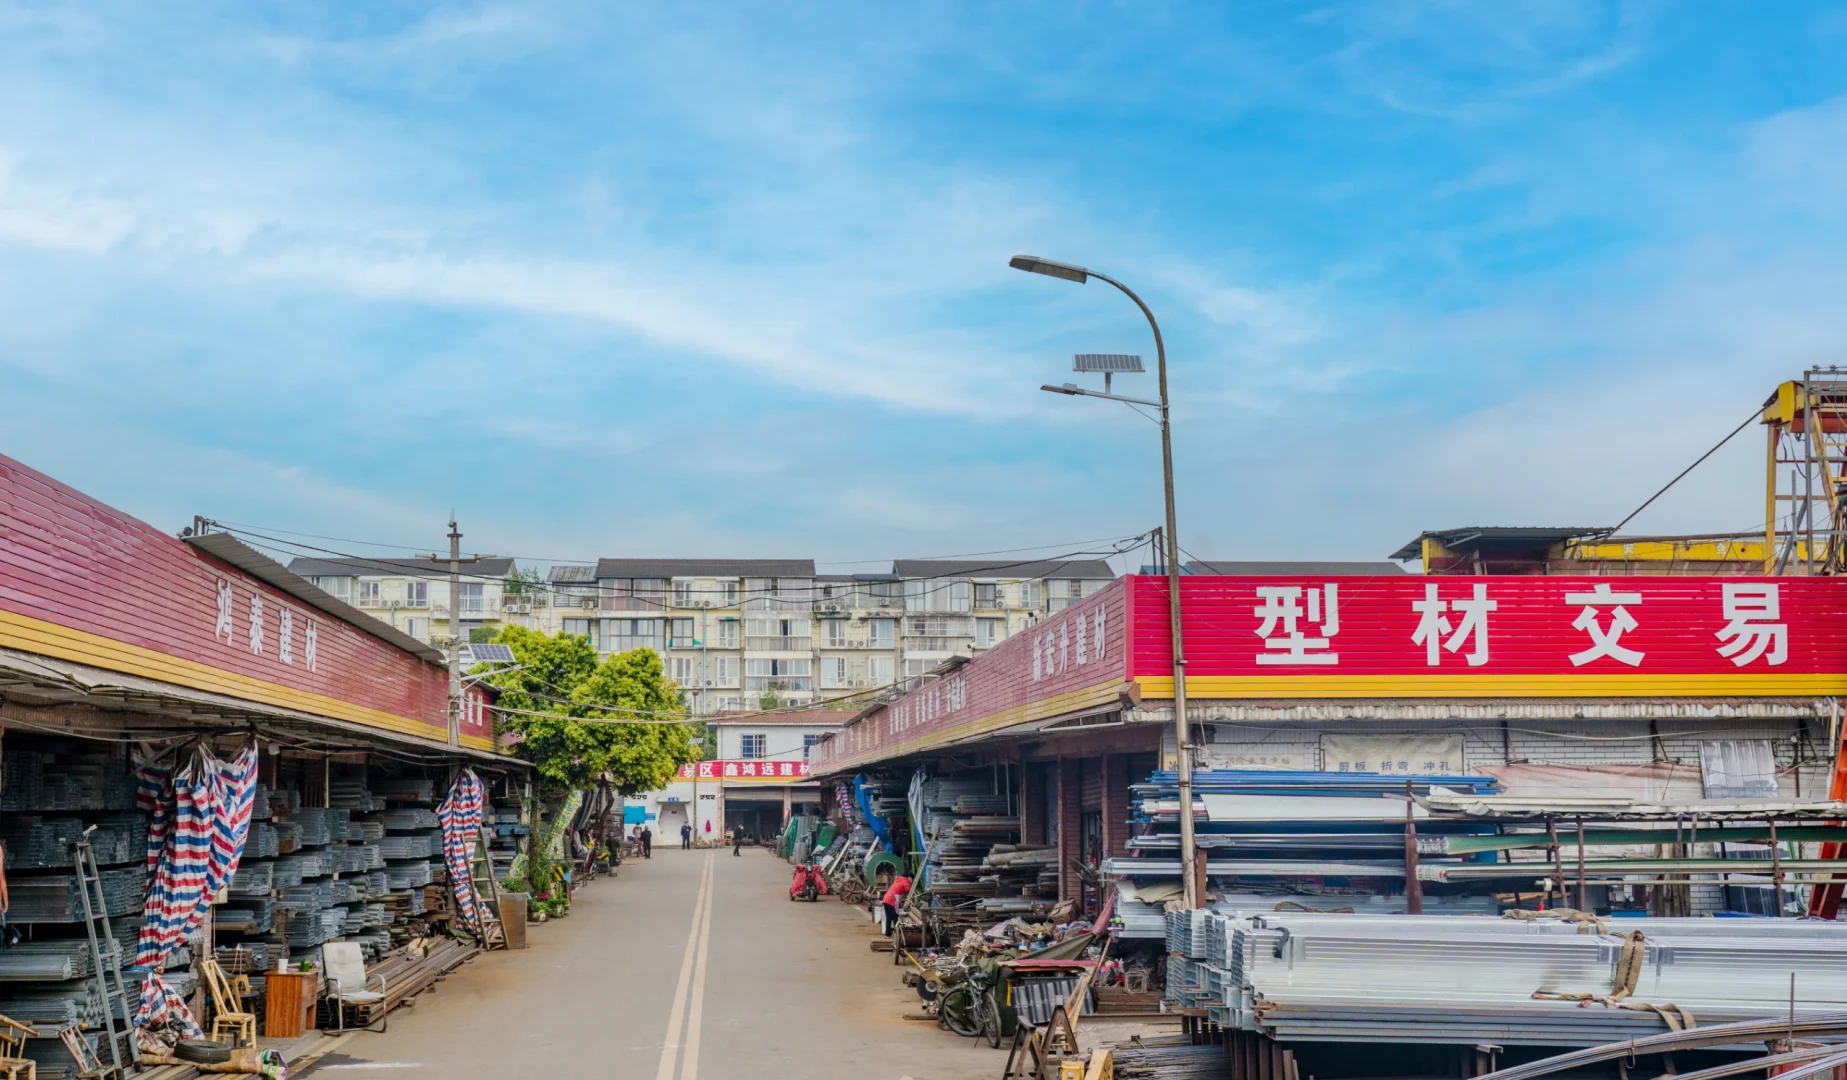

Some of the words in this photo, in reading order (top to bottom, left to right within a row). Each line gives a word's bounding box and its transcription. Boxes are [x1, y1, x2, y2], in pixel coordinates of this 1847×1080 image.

[215, 577, 318, 673] 鸿泰建材
[1254, 583, 1788, 667] 型材交易
[683, 763, 715, 778] 易区
[1338, 761, 1367, 772] 剪板
[1380, 761, 1409, 772] 折弯
[1424, 761, 1452, 772] 冲孔
